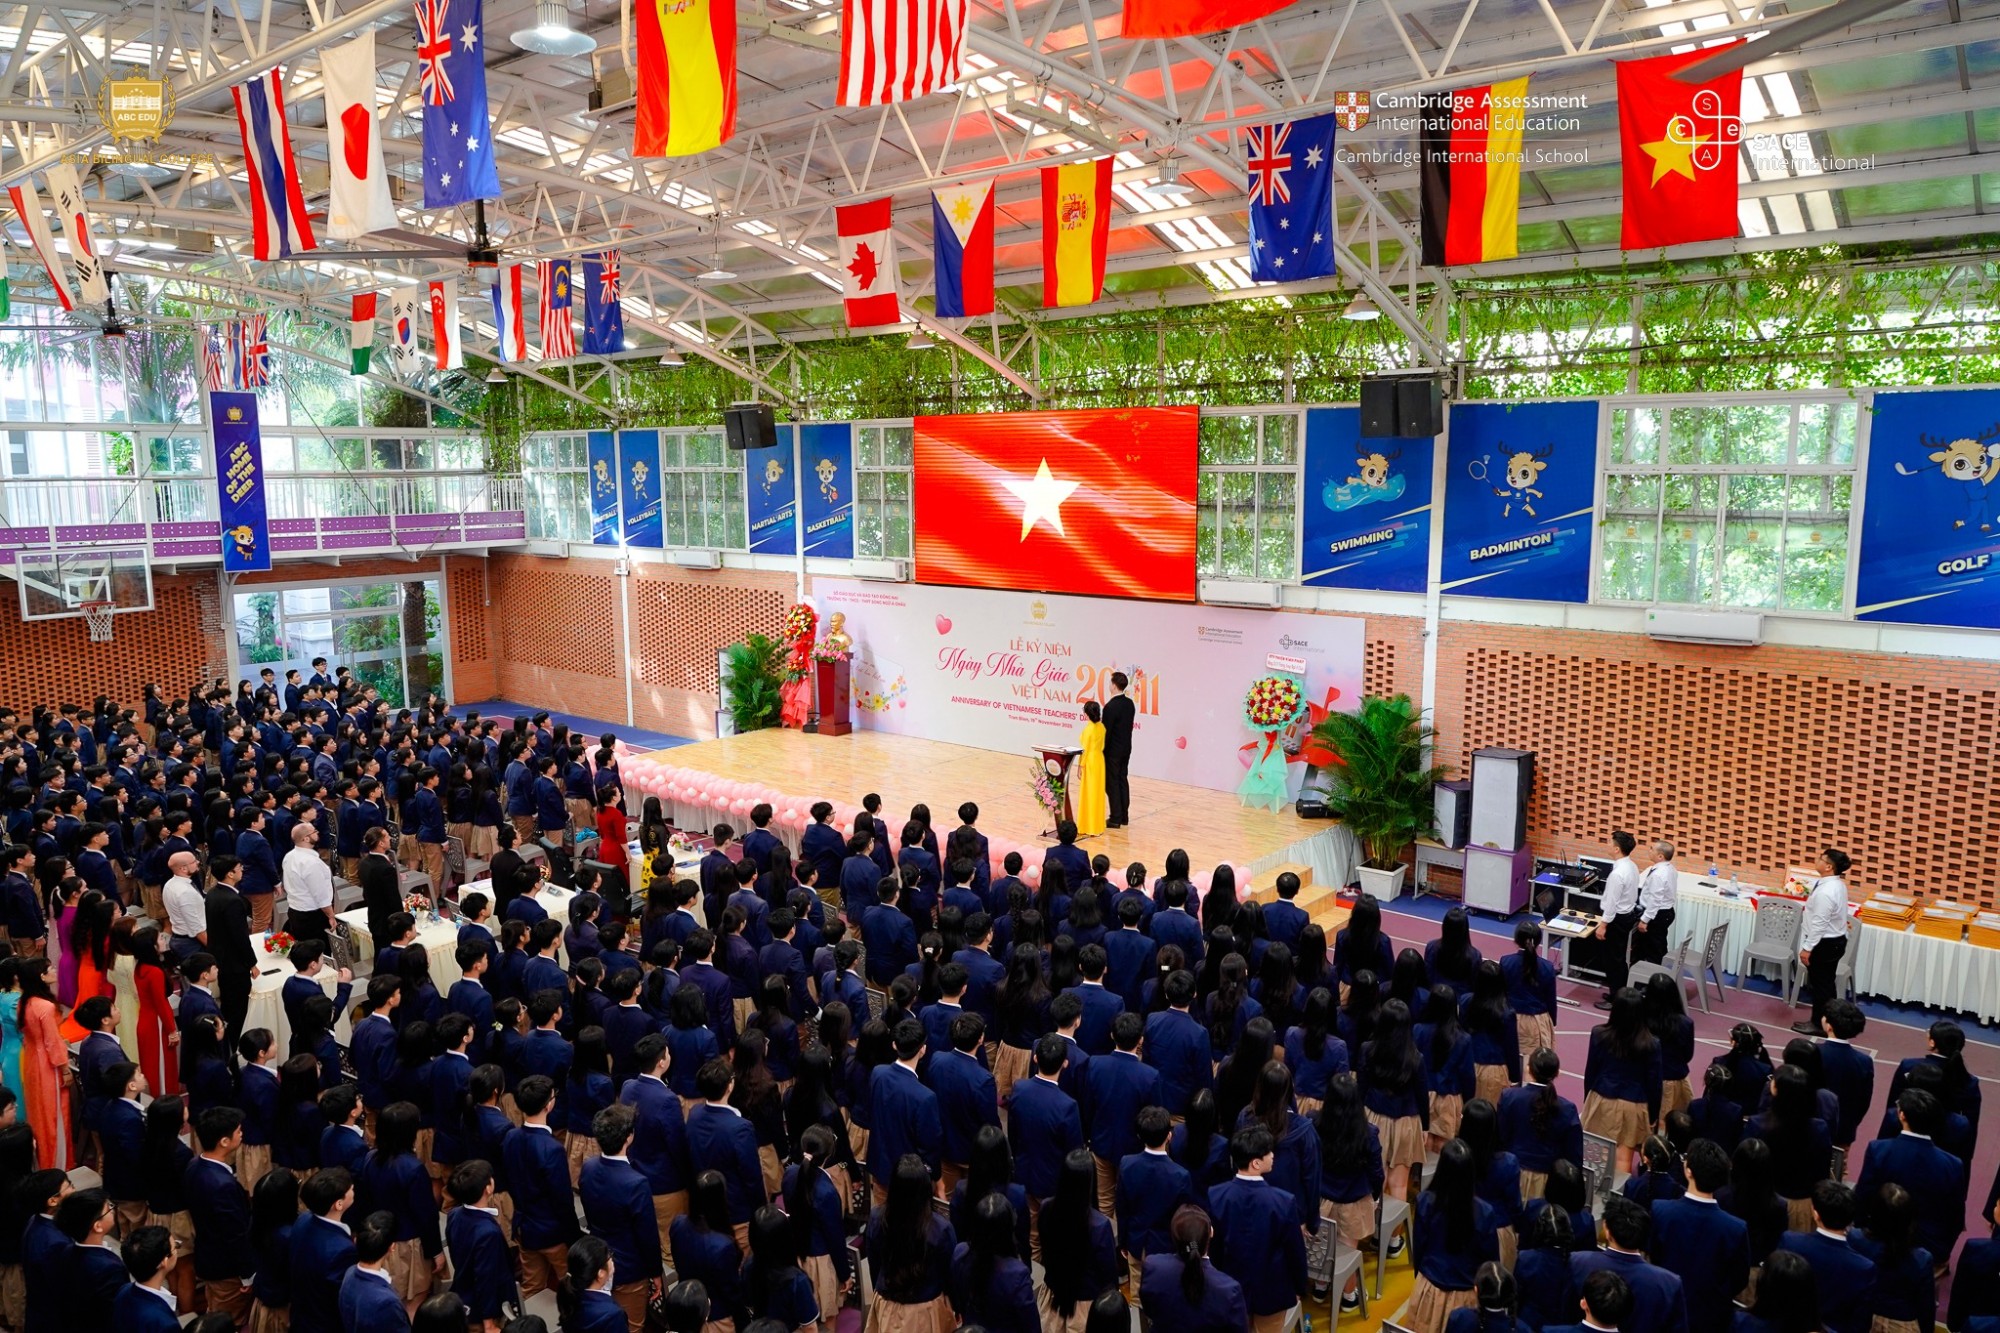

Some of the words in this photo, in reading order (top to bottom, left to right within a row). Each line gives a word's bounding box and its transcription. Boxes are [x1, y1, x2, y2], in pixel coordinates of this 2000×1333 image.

[229, 441, 248, 463] ABC
[226, 451, 253, 480] HOME
[225, 478, 239, 494] OF
[236, 462, 256, 482] THE
[230, 478, 255, 504] DEER
[626, 508, 657, 526] VOLLEYBALL
[751, 515, 777, 532] MARTIAL
[777, 509, 793, 522] ARTS
[806, 513, 846, 534] BASKETBALL
[1330, 528, 1394, 553] SWIMMING
[1470, 532, 1552, 561] BADMINTON
[1937, 554, 1989, 575] GOLF
[1010, 636, 1024, 651] LỄ
[1045, 642, 1071, 658] NIỆM
[936, 646, 983, 681] Ngày
[983, 652, 1026, 678] Nhà
[1031, 658, 1071, 688] Giáo
[1011, 683, 1041, 701] VIỆT
[1043, 688, 1072, 704] NAM
[951, 695, 992, 708] ANNIVERSARY
[992, 701, 1002, 709] OF
[1003, 702, 1042, 716] VIETNAMESE
[1043, 708, 1078, 721] TEACHERS'
